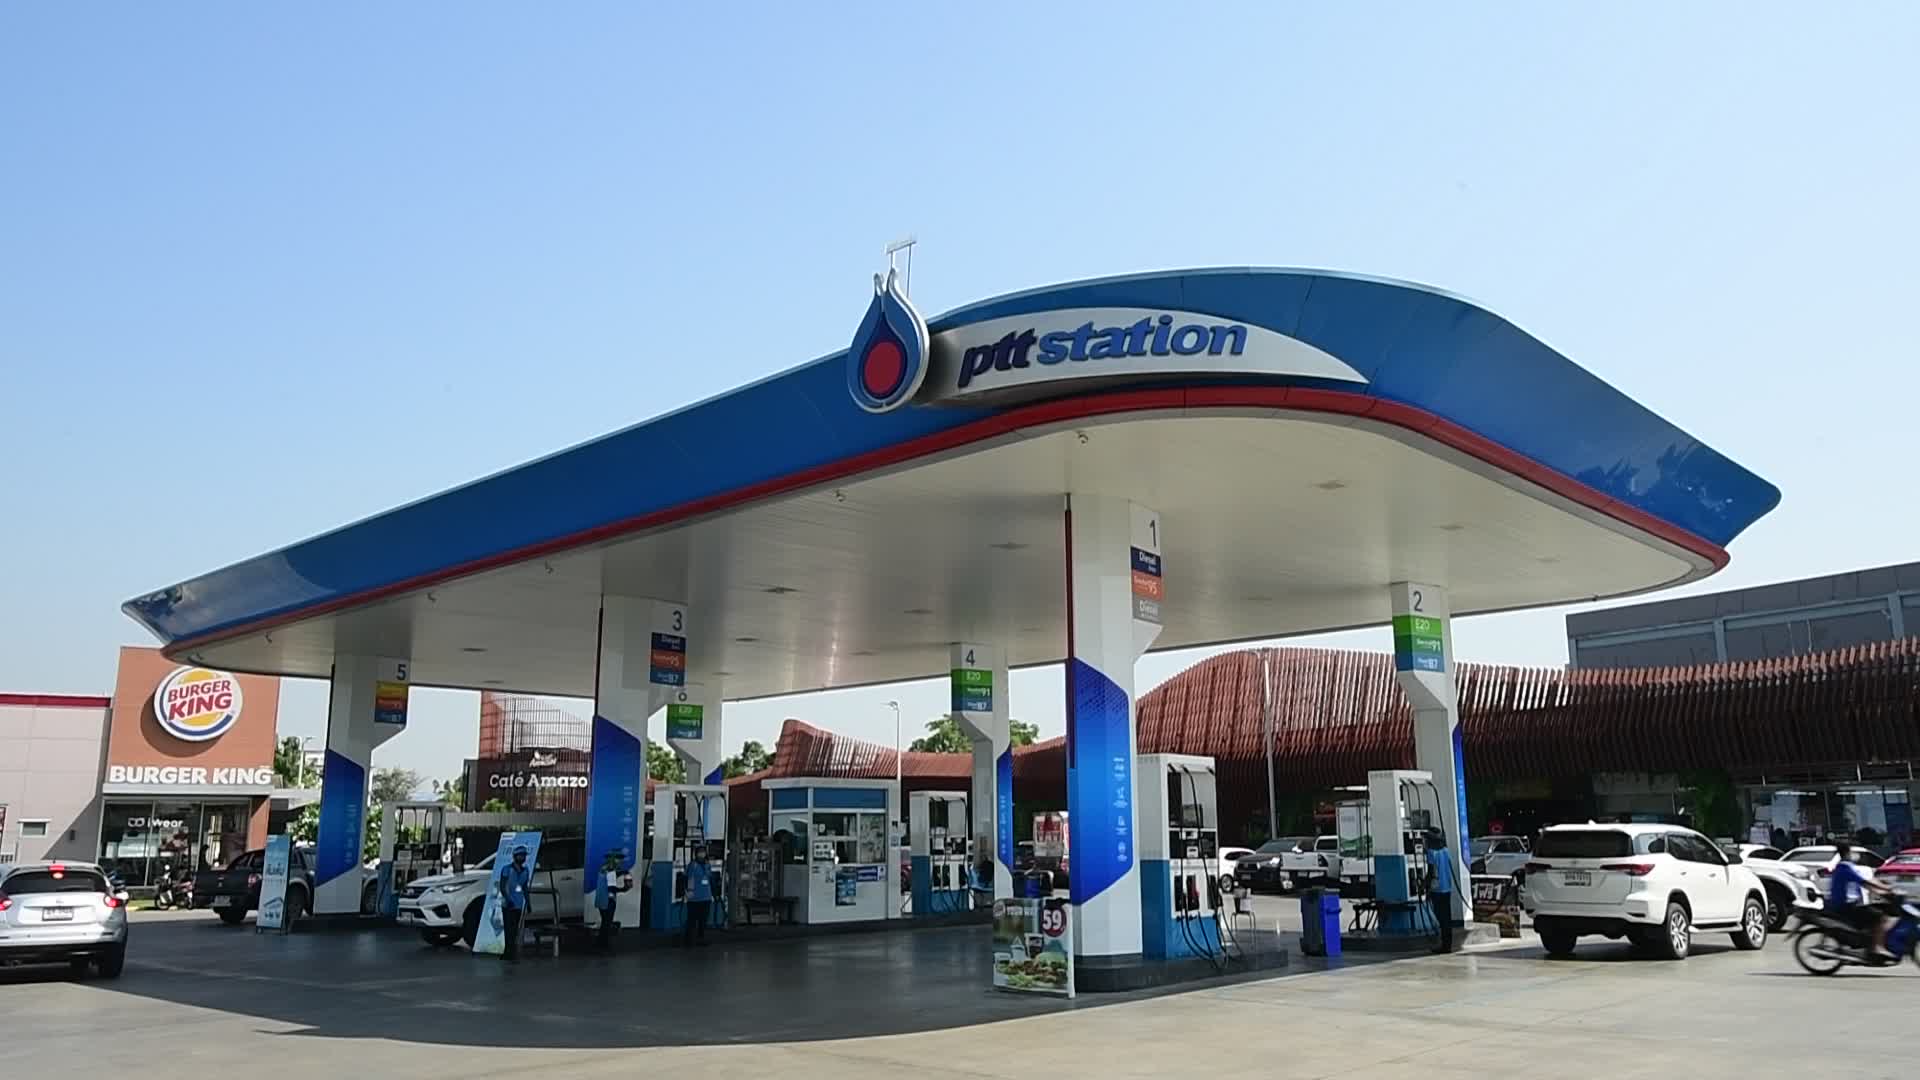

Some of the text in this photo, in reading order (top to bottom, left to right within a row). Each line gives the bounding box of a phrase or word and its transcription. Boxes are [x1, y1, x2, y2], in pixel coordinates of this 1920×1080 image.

[957, 314, 1248, 389] ptt station
[1149, 519, 1157, 548] 1
[1412, 590, 1424, 612] 2
[672, 609, 683, 631] 3
[1415, 617, 1431, 630] E20
[966, 649, 976, 667] 4
[396, 663, 407, 681] 5
[168, 680, 231, 703] BURGER
[168, 692, 233, 721] KING
[109, 766, 274, 785] BURGER KING
[489, 771, 525, 788] Café
[1042, 909, 1062, 931] 59
